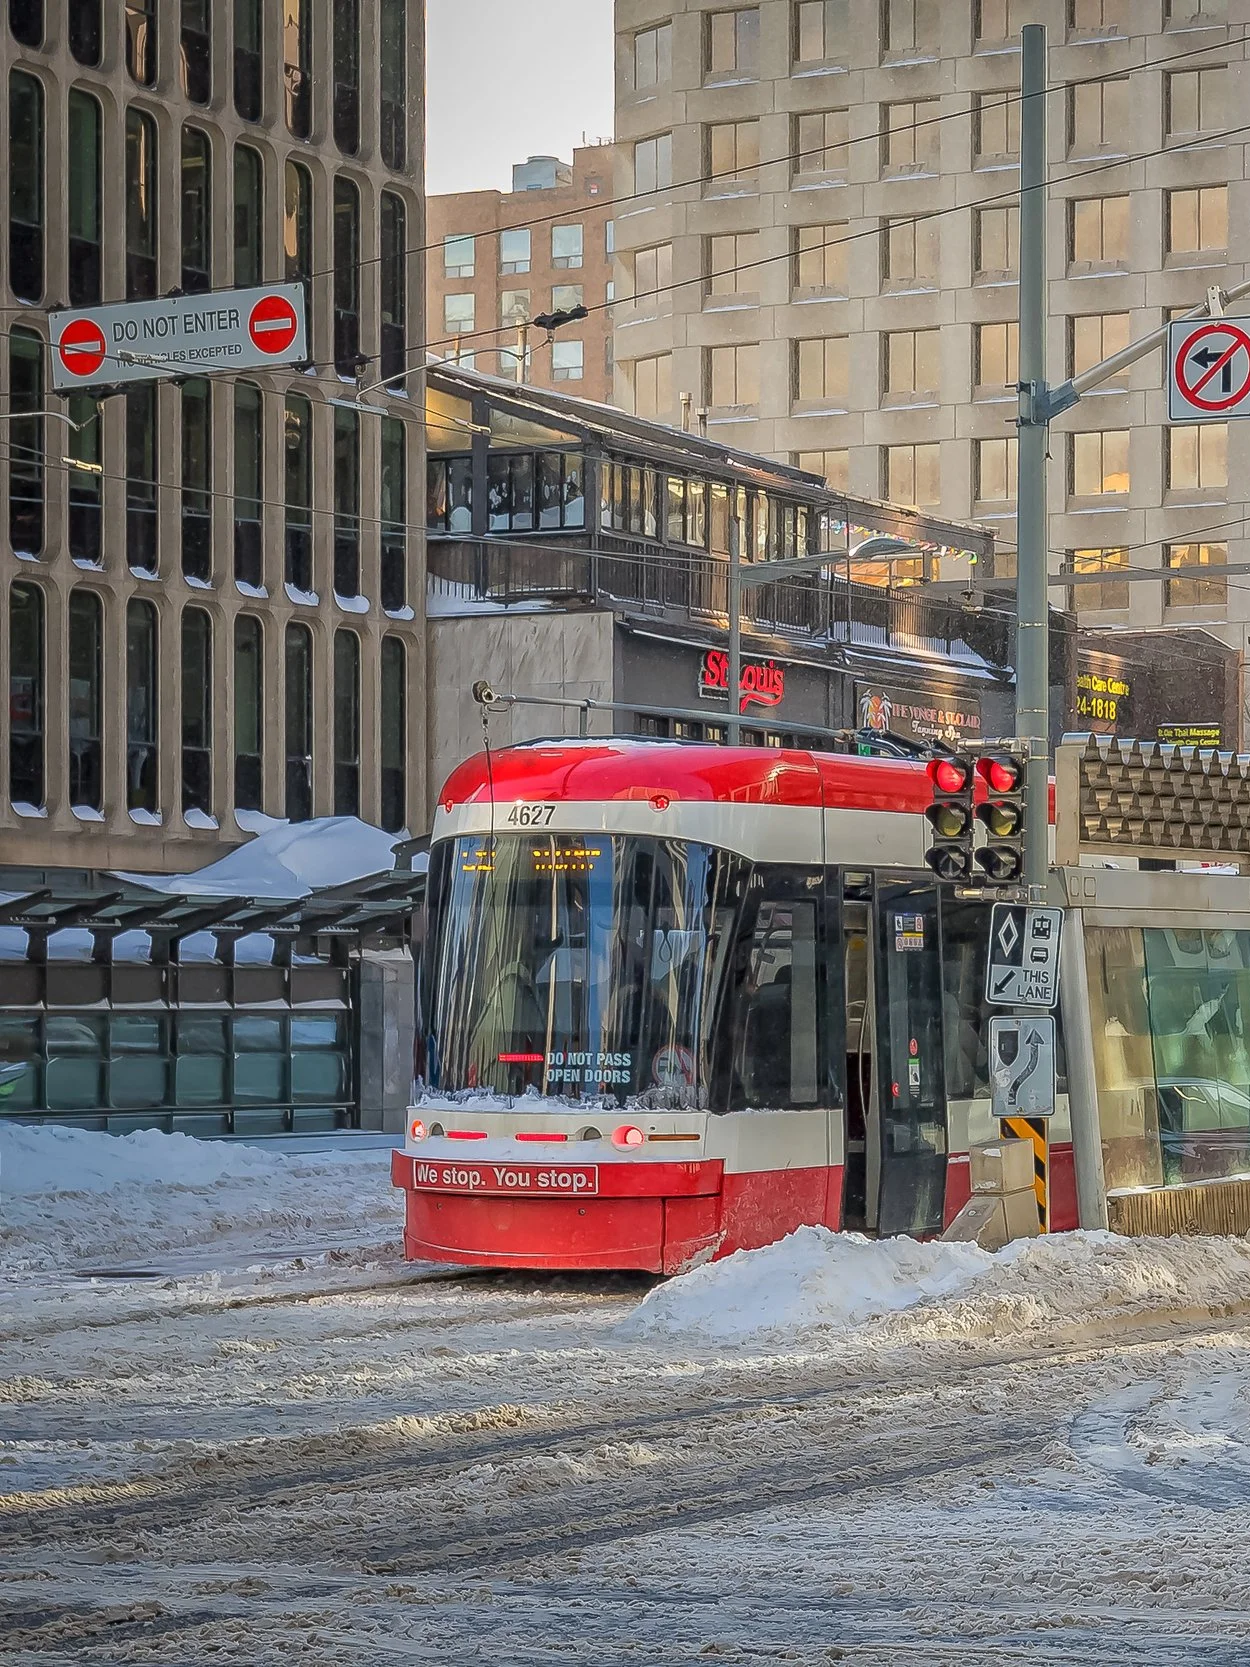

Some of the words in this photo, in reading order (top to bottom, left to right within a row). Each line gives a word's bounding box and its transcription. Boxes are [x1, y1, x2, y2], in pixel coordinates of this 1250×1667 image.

[112, 321, 138, 342] DO
[143, 315, 179, 338] NOT
[184, 308, 240, 334] ENTER
[188, 344, 242, 360] EXCEPTED
[738, 660, 784, 700] ouis
[1091, 675, 1107, 692] Care
[909, 705, 937, 723] YONGE
[937, 710, 945, 724] &
[507, 805, 556, 826] 4627
[1022, 969, 1049, 984] THIS
[1017, 984, 1052, 1000] LANE
[547, 1052, 564, 1067] DO
[567, 1052, 592, 1066] NOT
[596, 1052, 632, 1067] PASS
[546, 1068, 581, 1082] OPEN
[584, 1069, 631, 1083] DOORS
[417, 1164, 438, 1184] We
[442, 1165, 487, 1190] stop.
[493, 1167, 531, 1188] You
[537, 1169, 593, 1193] stop.
